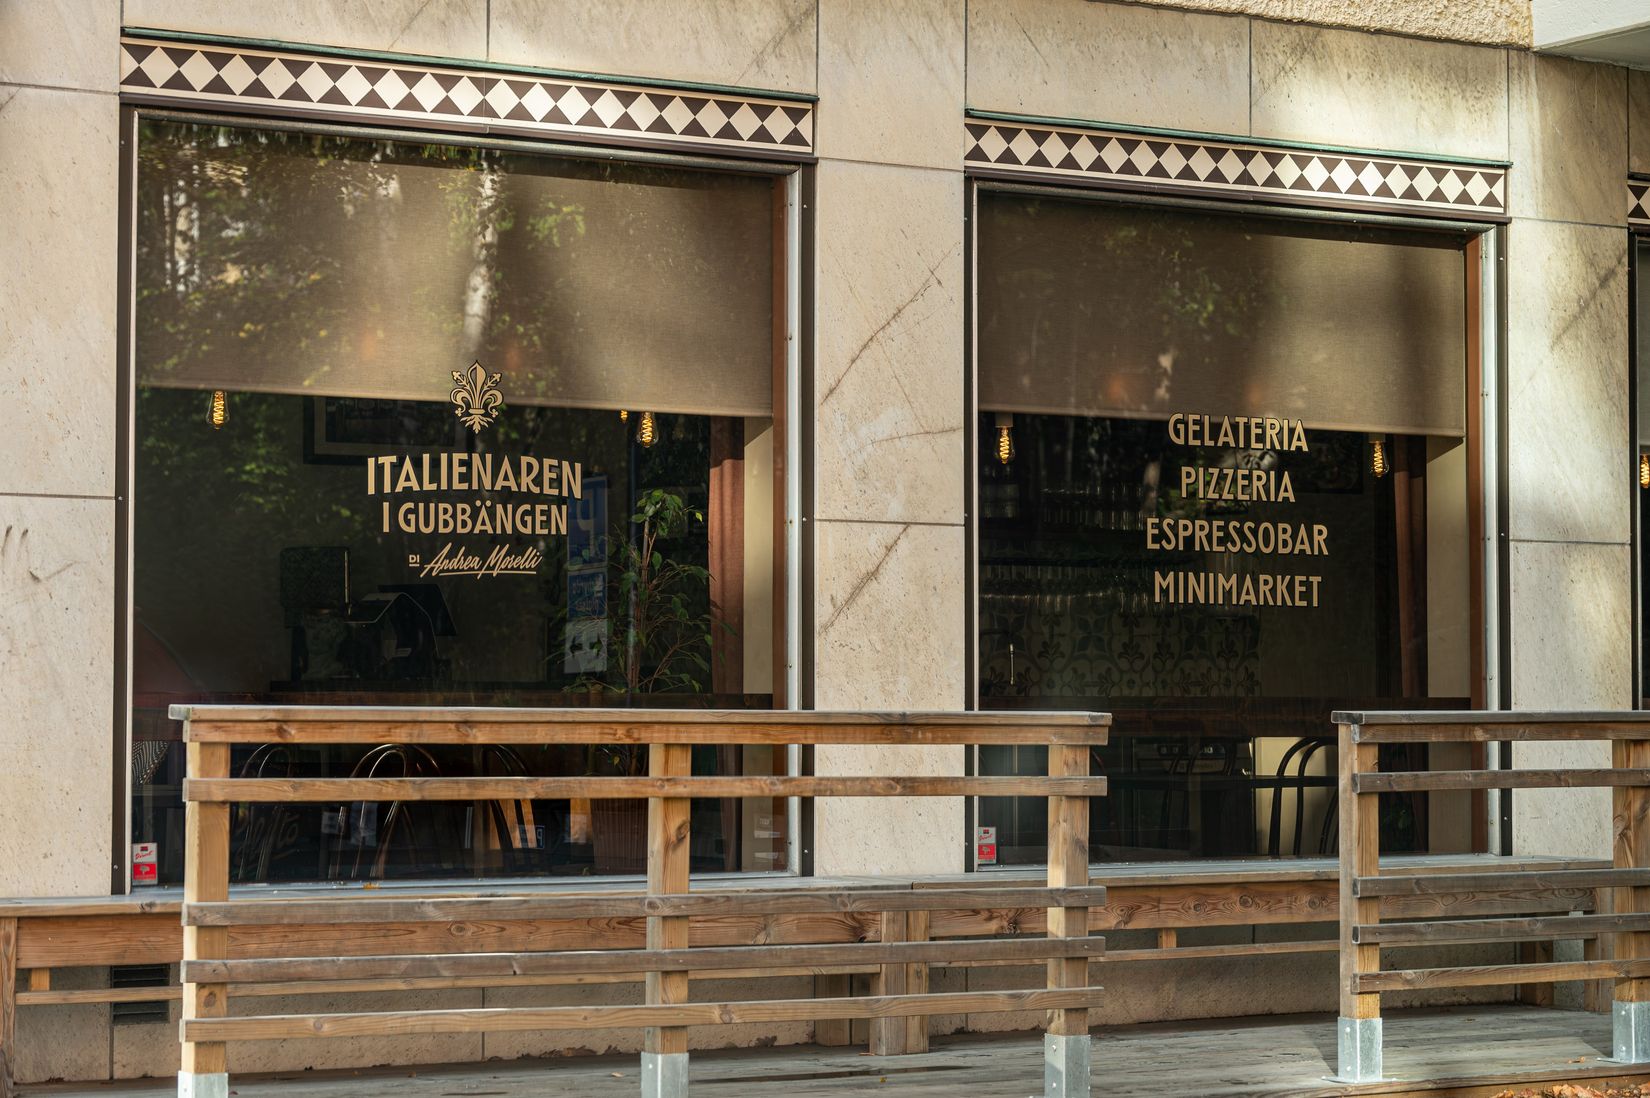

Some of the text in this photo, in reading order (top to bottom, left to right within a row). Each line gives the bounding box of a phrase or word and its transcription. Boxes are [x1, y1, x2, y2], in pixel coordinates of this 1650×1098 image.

[1168, 413, 1308, 452] GELATERIA
[367, 452, 582, 499] ITALIENAREN
[1181, 466, 1295, 503] PIZZERIA
[382, 500, 568, 535] I GUBBÄNGEN
[1146, 518, 1328, 556] ESPRESSOBAR
[408, 542, 542, 579] DI Andrea Morelli
[1154, 571, 1322, 607] MINIMARKET
